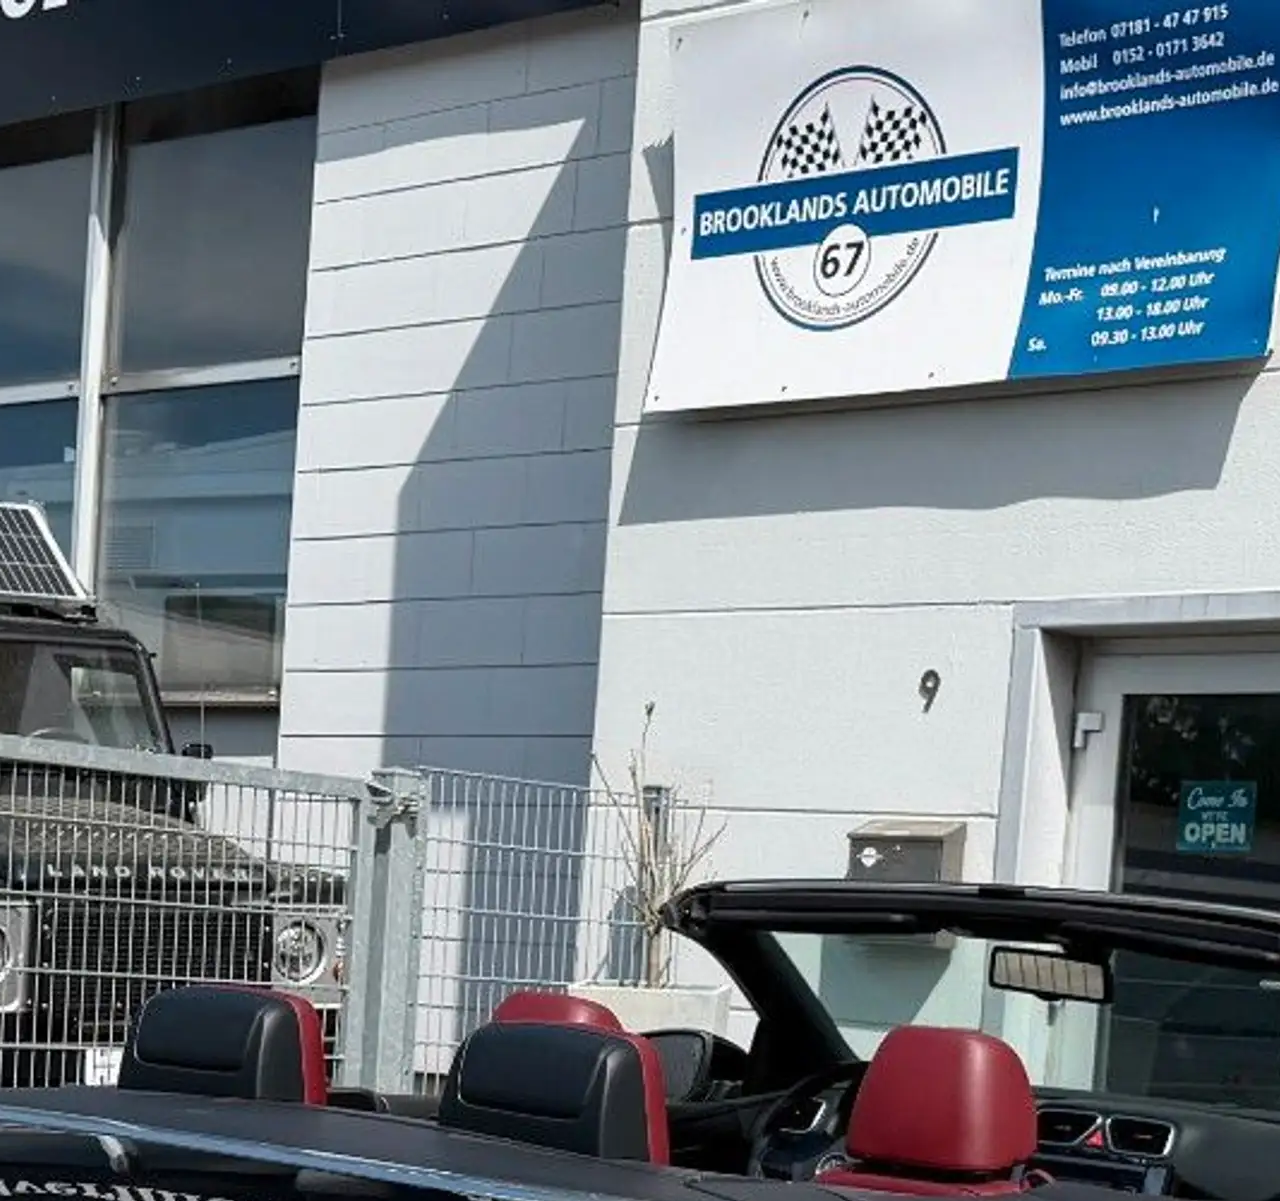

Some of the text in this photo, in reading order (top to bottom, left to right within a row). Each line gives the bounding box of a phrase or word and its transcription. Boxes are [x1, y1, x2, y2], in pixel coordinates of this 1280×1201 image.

[1058, 28, 1107, 48] Telefon
[1110, 17, 1151, 38] 07181
[1163, 11, 1180, 29] 47
[1182, 8, 1200, 26] 47
[1202, 3, 1229, 23] 915
[1060, 53, 1098, 74] Mobil
[1112, 45, 1145, 66] 0152
[1156, 38, 1188, 58] 0171
[1060, 51, 1275, 100] info@brooklands-automobile.de
[1060, 78, 1279, 126] www.brooklands-automobile.de
[699, 168, 1010, 236] BROOKLANDS AUTOMOBILE
[820, 240, 864, 279] 67
[1044, 247, 1227, 282] Termine nach Vereinbarung
[1150, 275, 1187, 293] 12.00
[1189, 271, 1216, 287] Uhr
[1183, 295, 1210, 312] Uhr
[1178, 319, 1206, 336] Uhr
[918, 669, 941, 713] 9
[1184, 822, 1246, 844] OPEN
[46, 863, 131, 878] LAND
